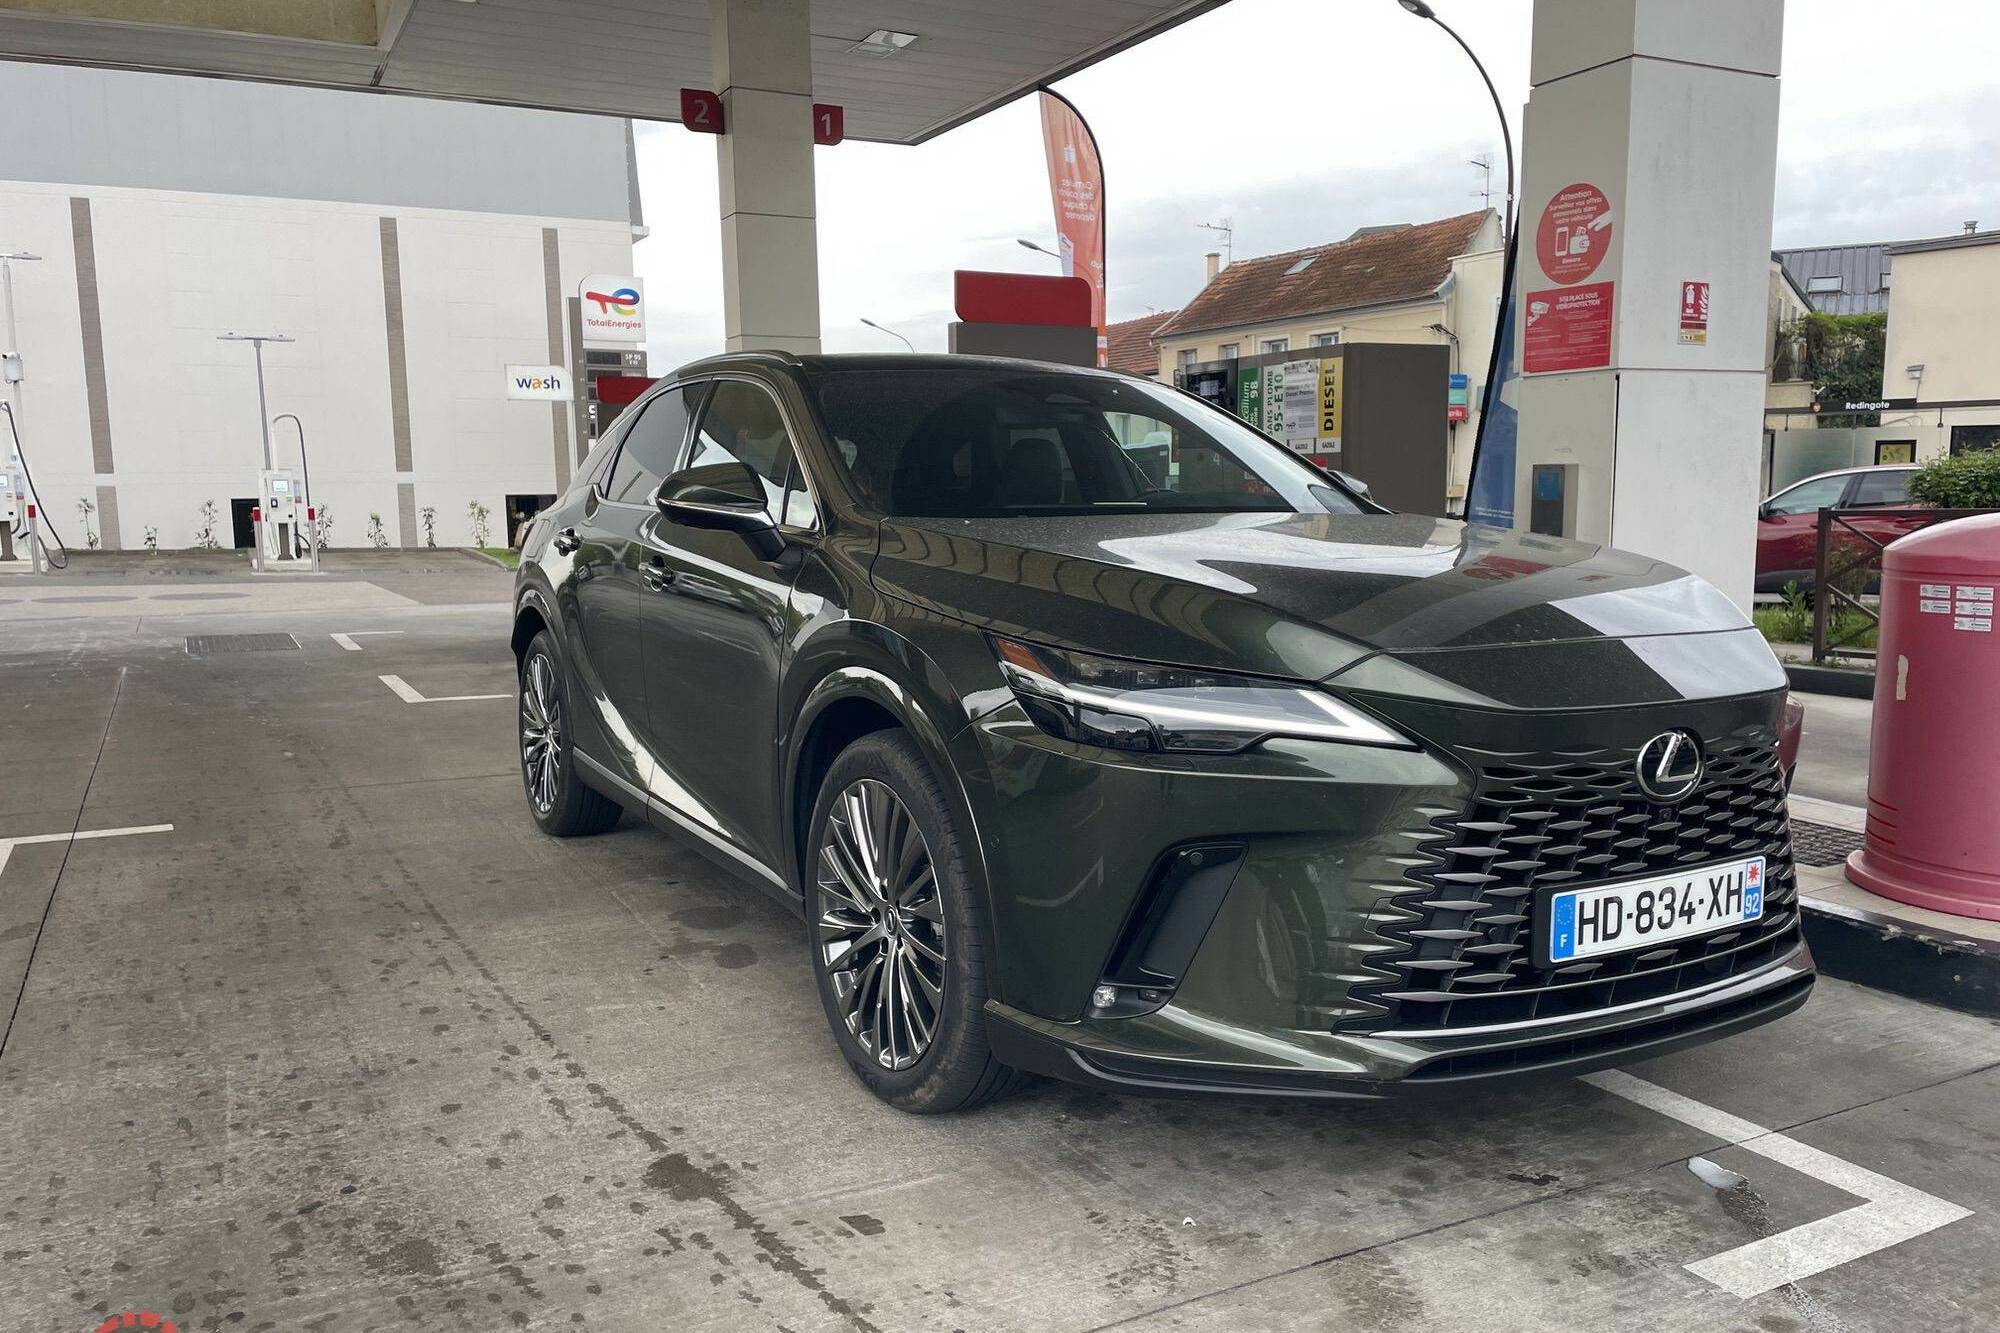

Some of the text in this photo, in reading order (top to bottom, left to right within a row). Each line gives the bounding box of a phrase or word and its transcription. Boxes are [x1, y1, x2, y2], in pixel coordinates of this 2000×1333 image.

[694, 99, 709, 124] 2
[821, 113, 831, 136] 1
[1560, 190, 1592, 201] Attention
[587, 319, 642, 329] TotalEnergies
[516, 375, 561, 390] wash
[1250, 380, 1259, 399] 98
[1274, 374, 1284, 432] 95-E10
[1324, 364, 1335, 431] DIESEL
[1845, 401, 1890, 411] Redingote
[1578, 871, 1744, 946] HD-834-XH
[1744, 892, 1759, 914] 92
[1559, 934, 1569, 948] F
